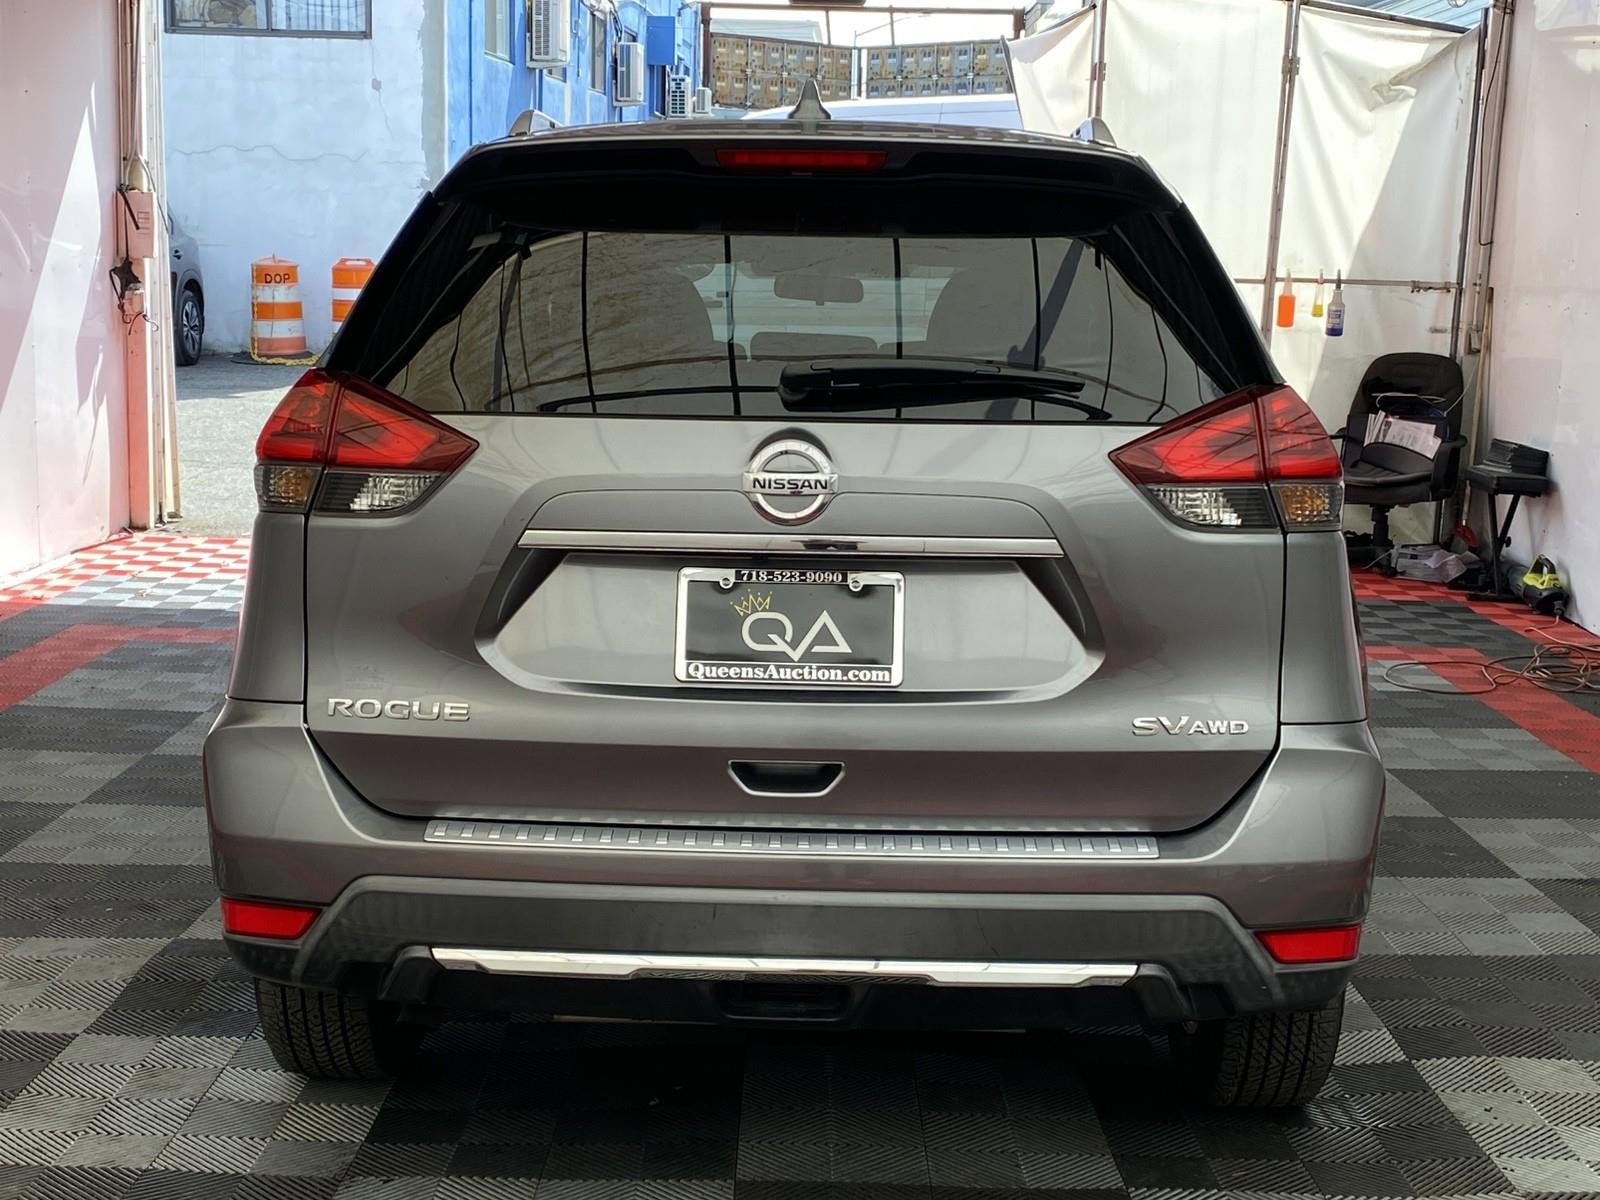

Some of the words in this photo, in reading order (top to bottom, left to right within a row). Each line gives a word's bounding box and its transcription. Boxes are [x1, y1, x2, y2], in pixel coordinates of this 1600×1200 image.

[264, 273, 291, 284] DOP
[752, 477, 829, 490] NISSAN
[740, 569, 843, 583] 718-523-9090
[741, 609, 853, 663] QA
[687, 663, 891, 683] QueensAuction.com
[327, 698, 470, 722] ROGUE
[1132, 716, 1190, 736] SV
[1187, 720, 1249, 736] AWD
